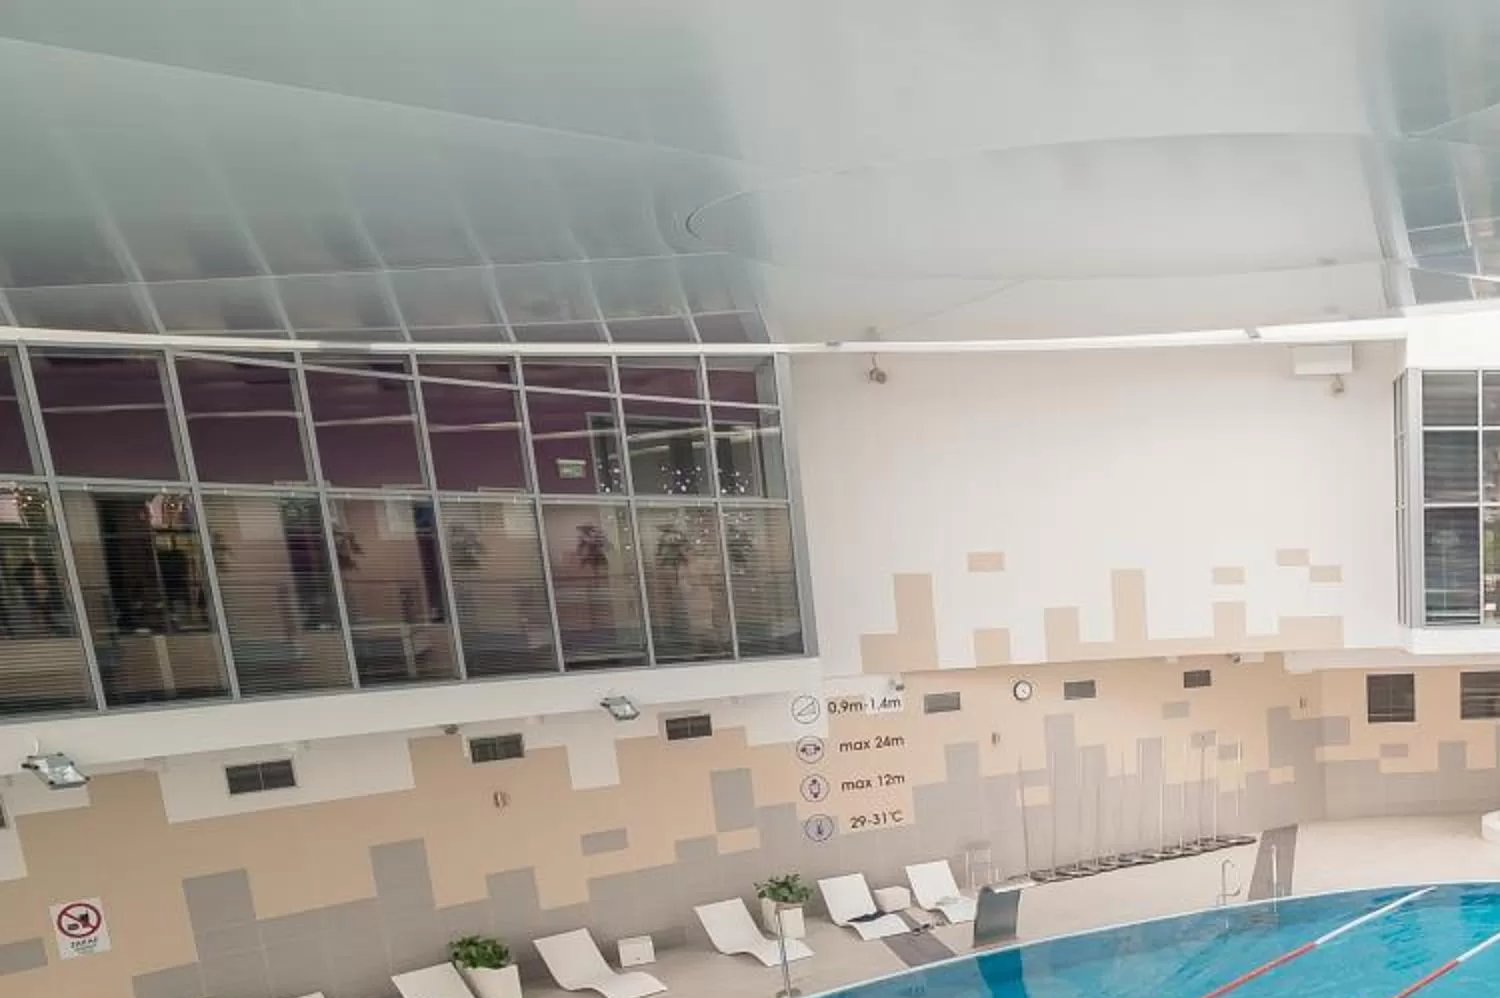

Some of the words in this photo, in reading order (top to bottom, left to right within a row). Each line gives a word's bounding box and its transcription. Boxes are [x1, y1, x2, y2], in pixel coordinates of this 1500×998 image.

[839, 740, 870, 752] max
[875, 736, 904, 748] 24m
[841, 779, 872, 792] max
[877, 773, 905, 786] 12m
